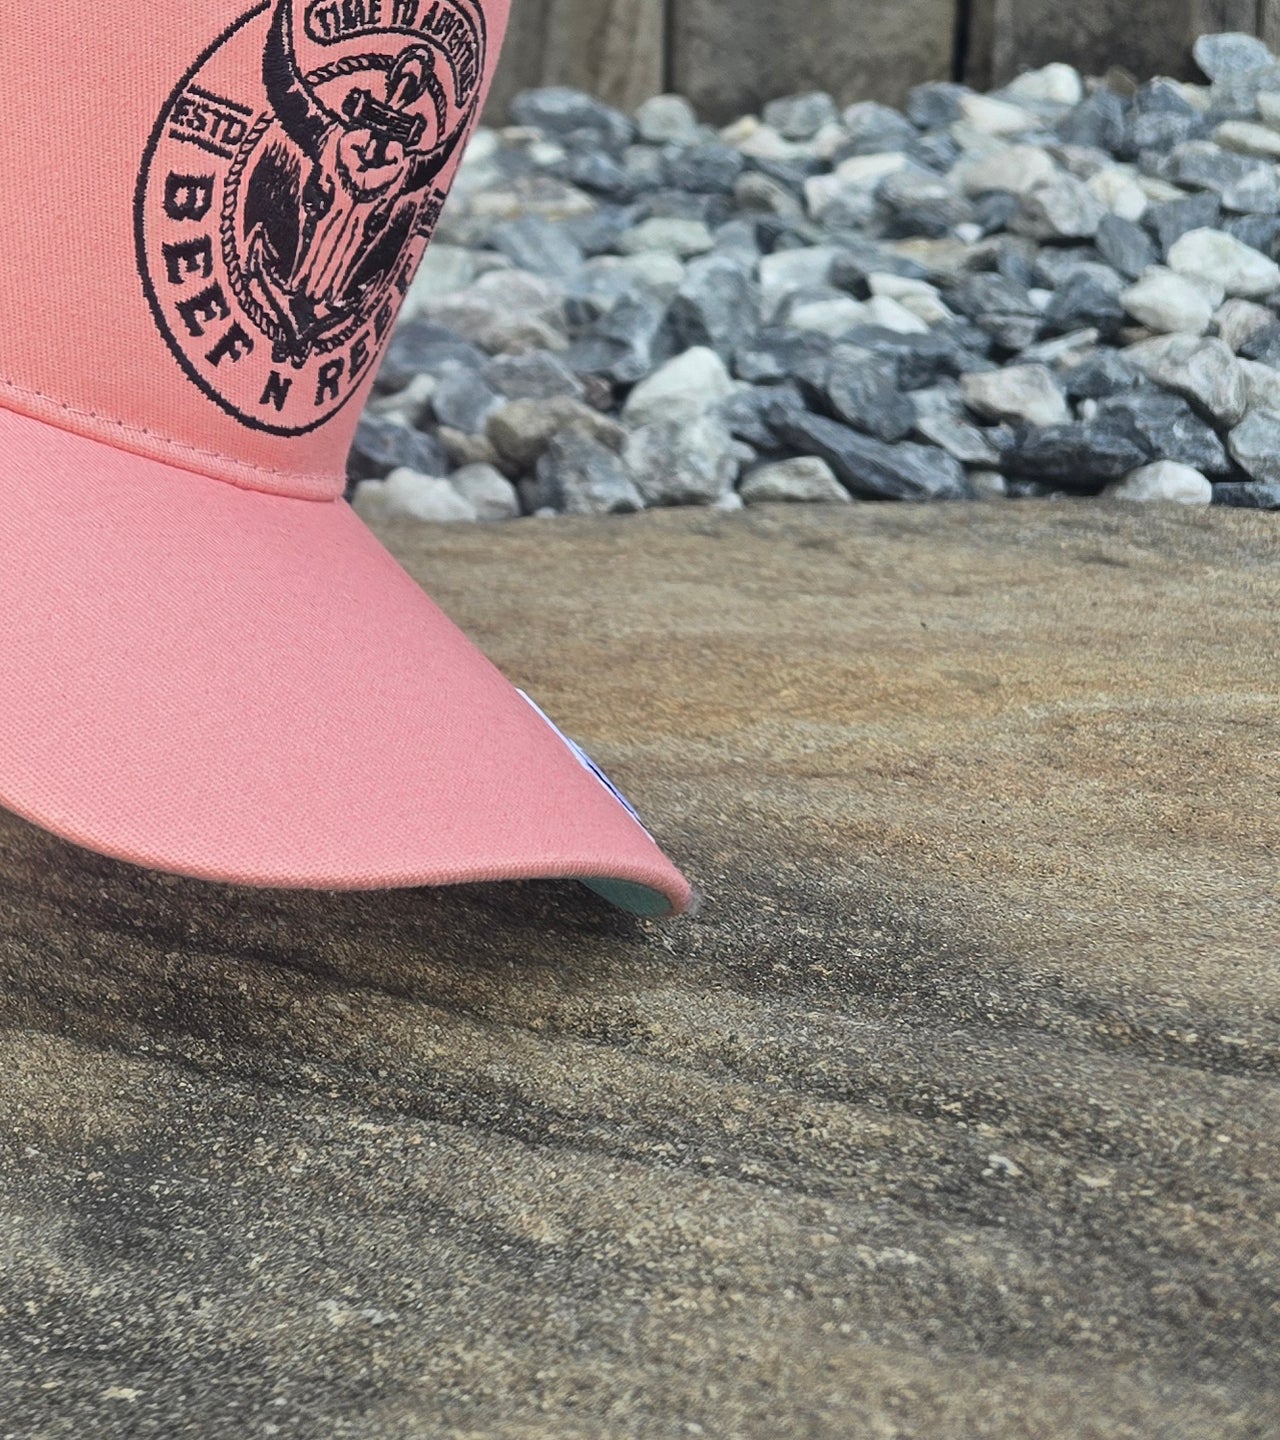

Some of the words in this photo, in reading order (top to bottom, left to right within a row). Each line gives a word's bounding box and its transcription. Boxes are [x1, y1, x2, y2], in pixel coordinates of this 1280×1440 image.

[170, 96, 248, 146] ESTD
[161, 170, 254, 369] BEEF
[259, 369, 293, 412] N
